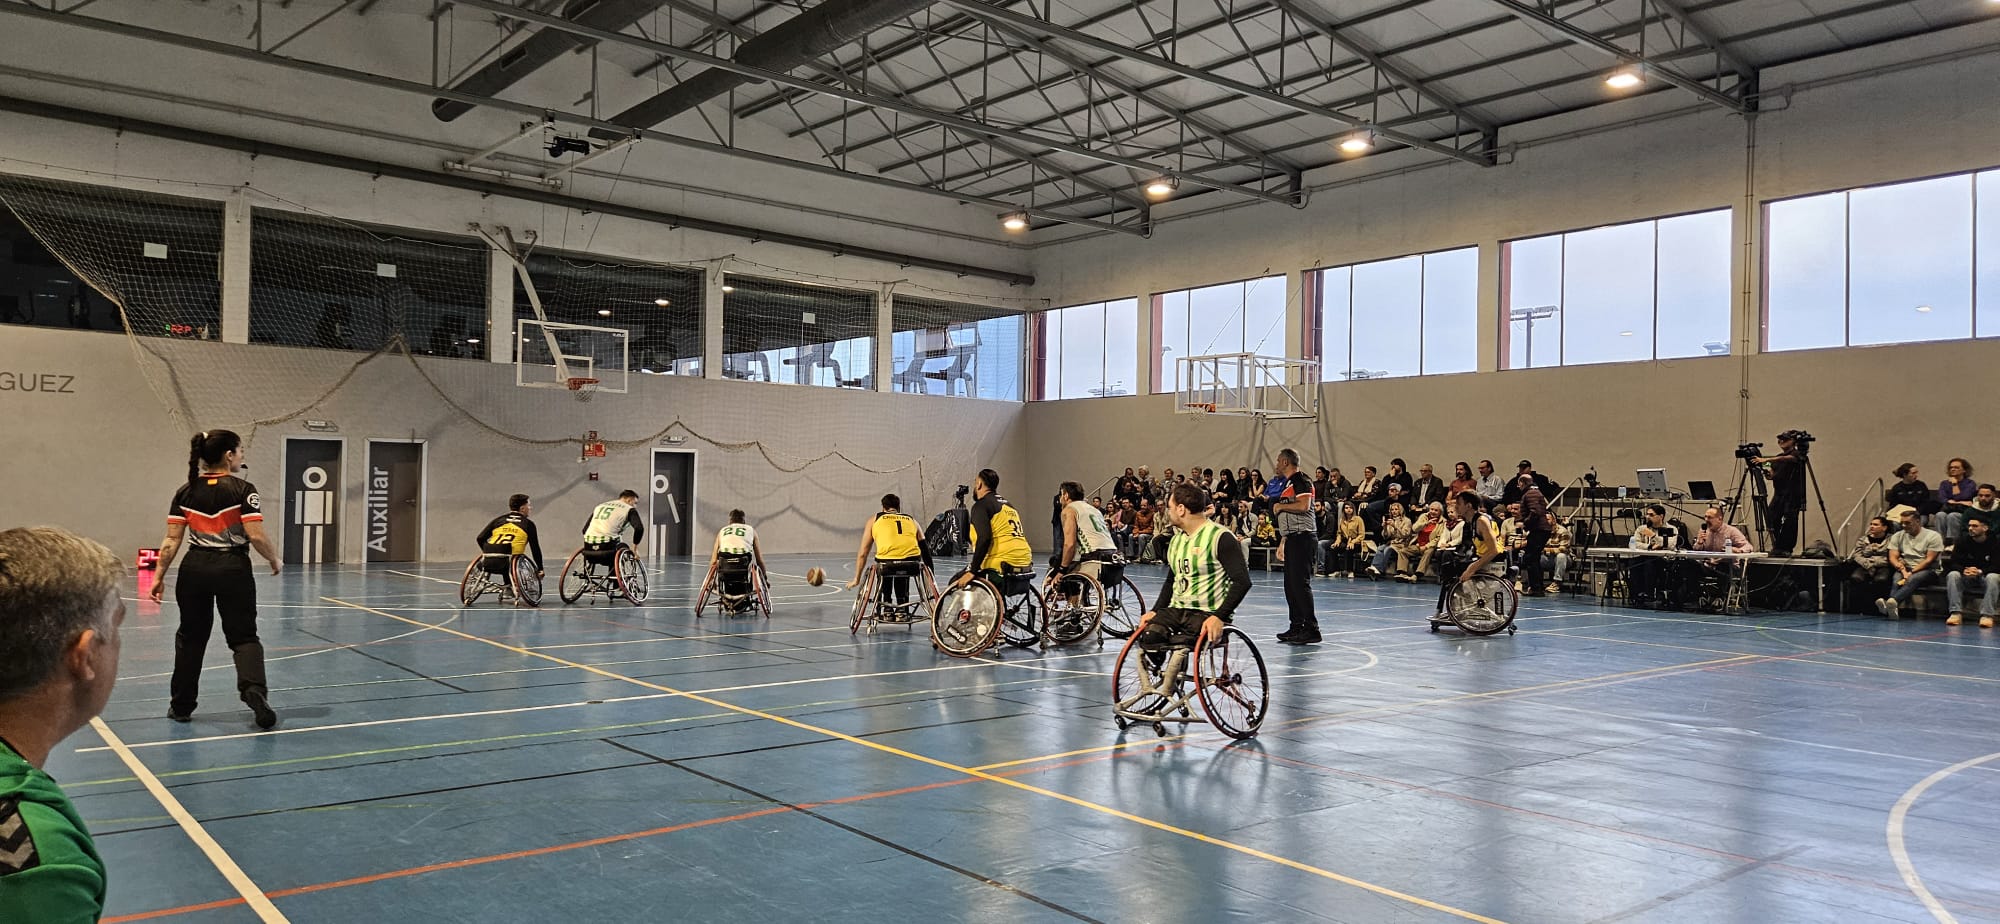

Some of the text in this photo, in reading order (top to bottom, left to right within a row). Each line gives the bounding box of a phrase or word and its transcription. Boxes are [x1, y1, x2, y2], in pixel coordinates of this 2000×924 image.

[0, 371, 75, 393] GUEZ
[367, 466, 389, 553] Auxiliar
[594, 506, 615, 520] 15
[895, 520, 903, 535] 1
